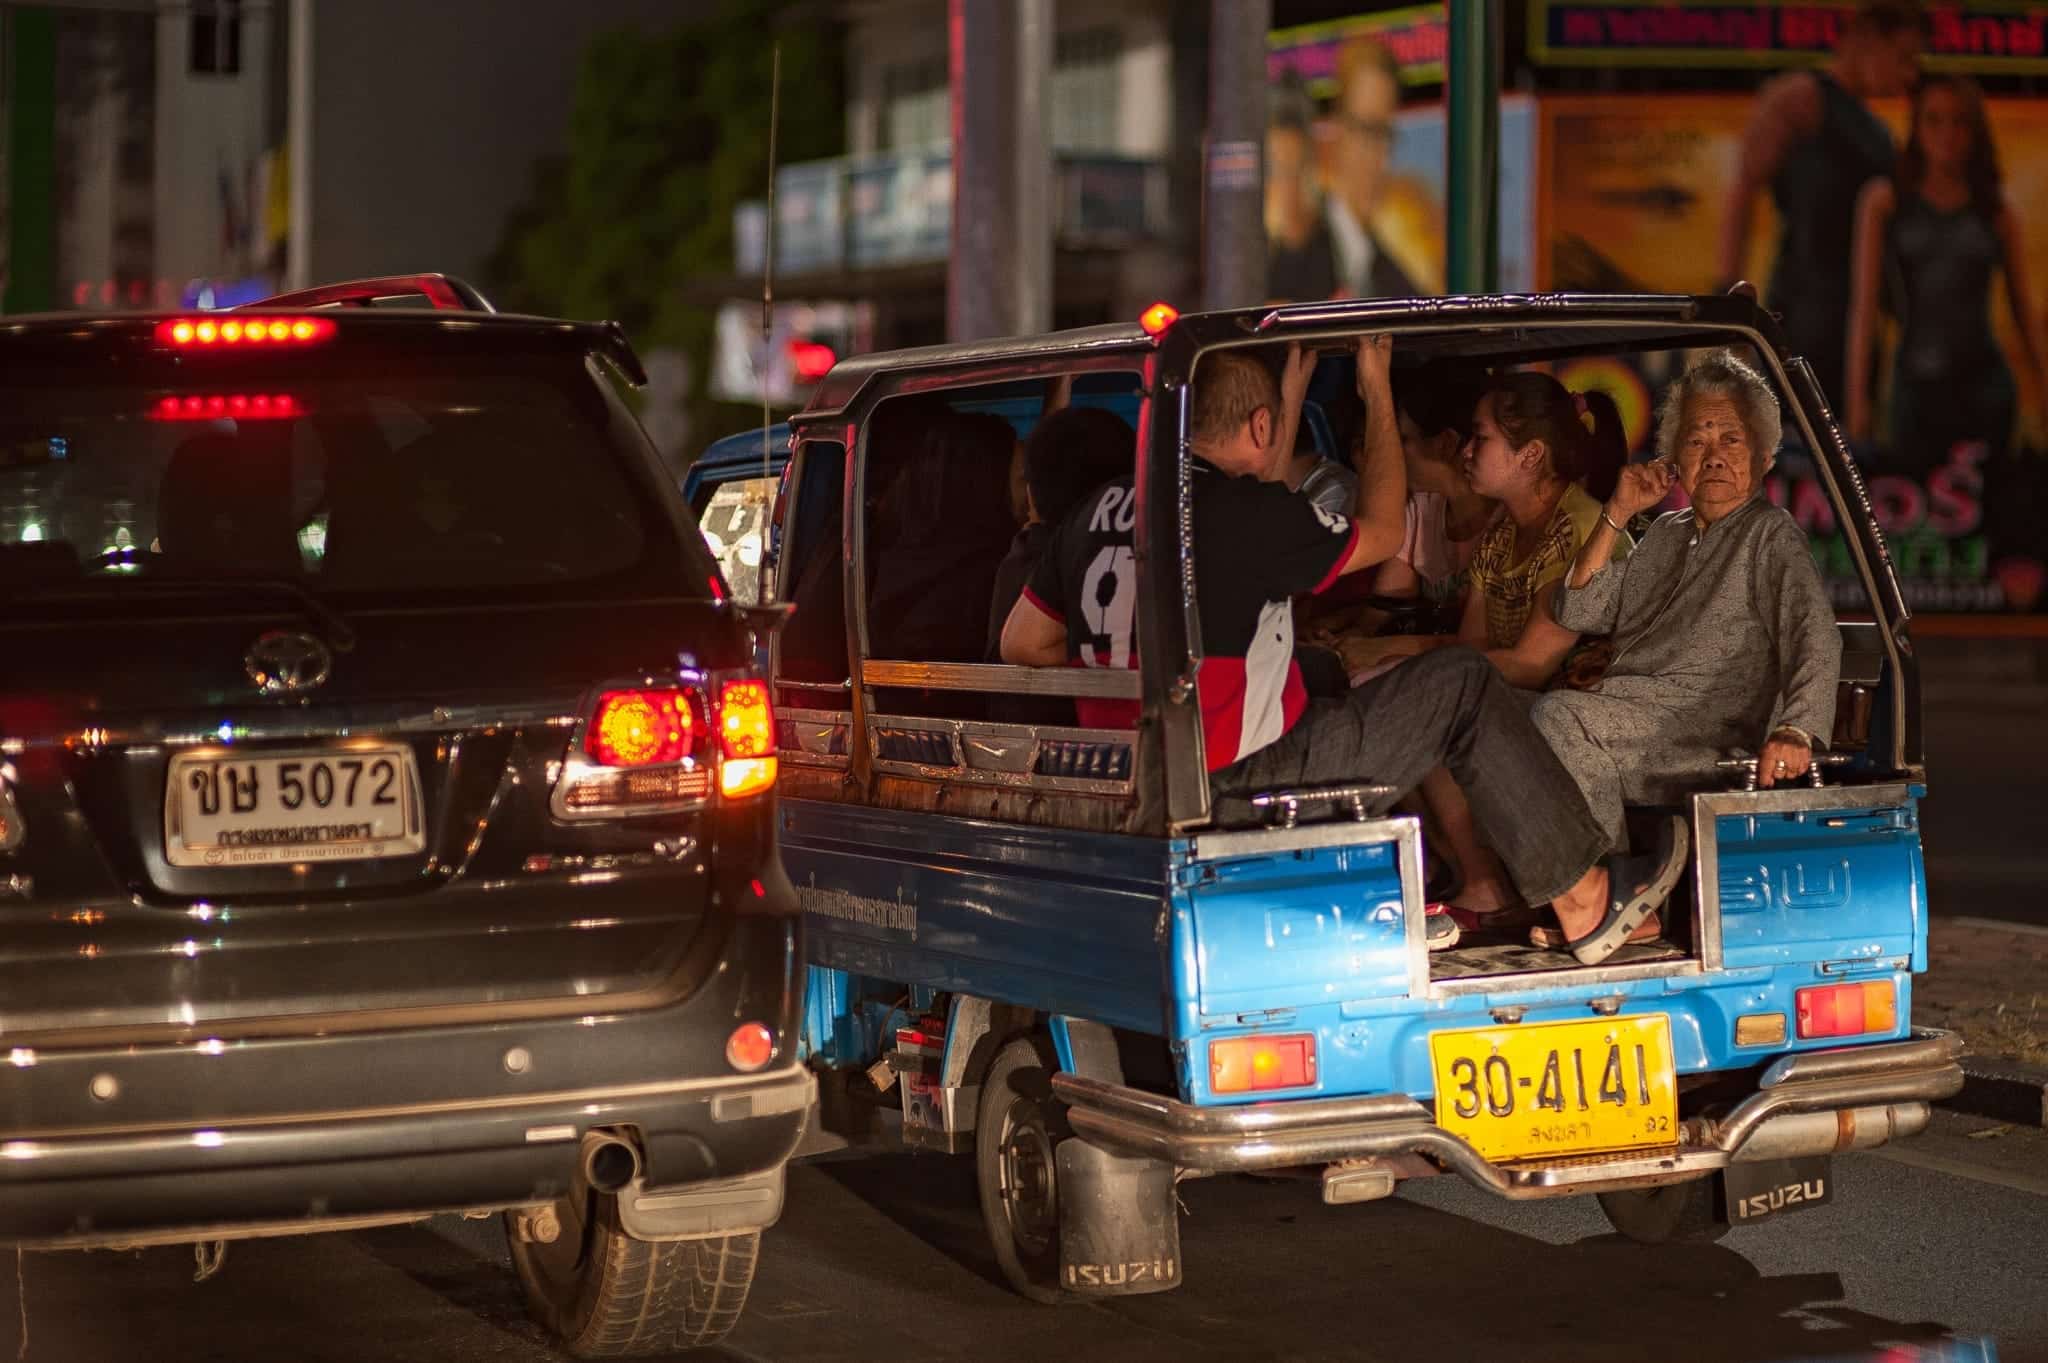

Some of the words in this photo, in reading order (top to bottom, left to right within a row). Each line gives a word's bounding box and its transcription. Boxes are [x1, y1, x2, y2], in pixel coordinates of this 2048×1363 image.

[278, 758, 398, 811] 5072
[1450, 1043, 1651, 1119] 30-4141
[1738, 1178, 1824, 1218] ISUZU
[1067, 1256, 1175, 1286] ISUZU
